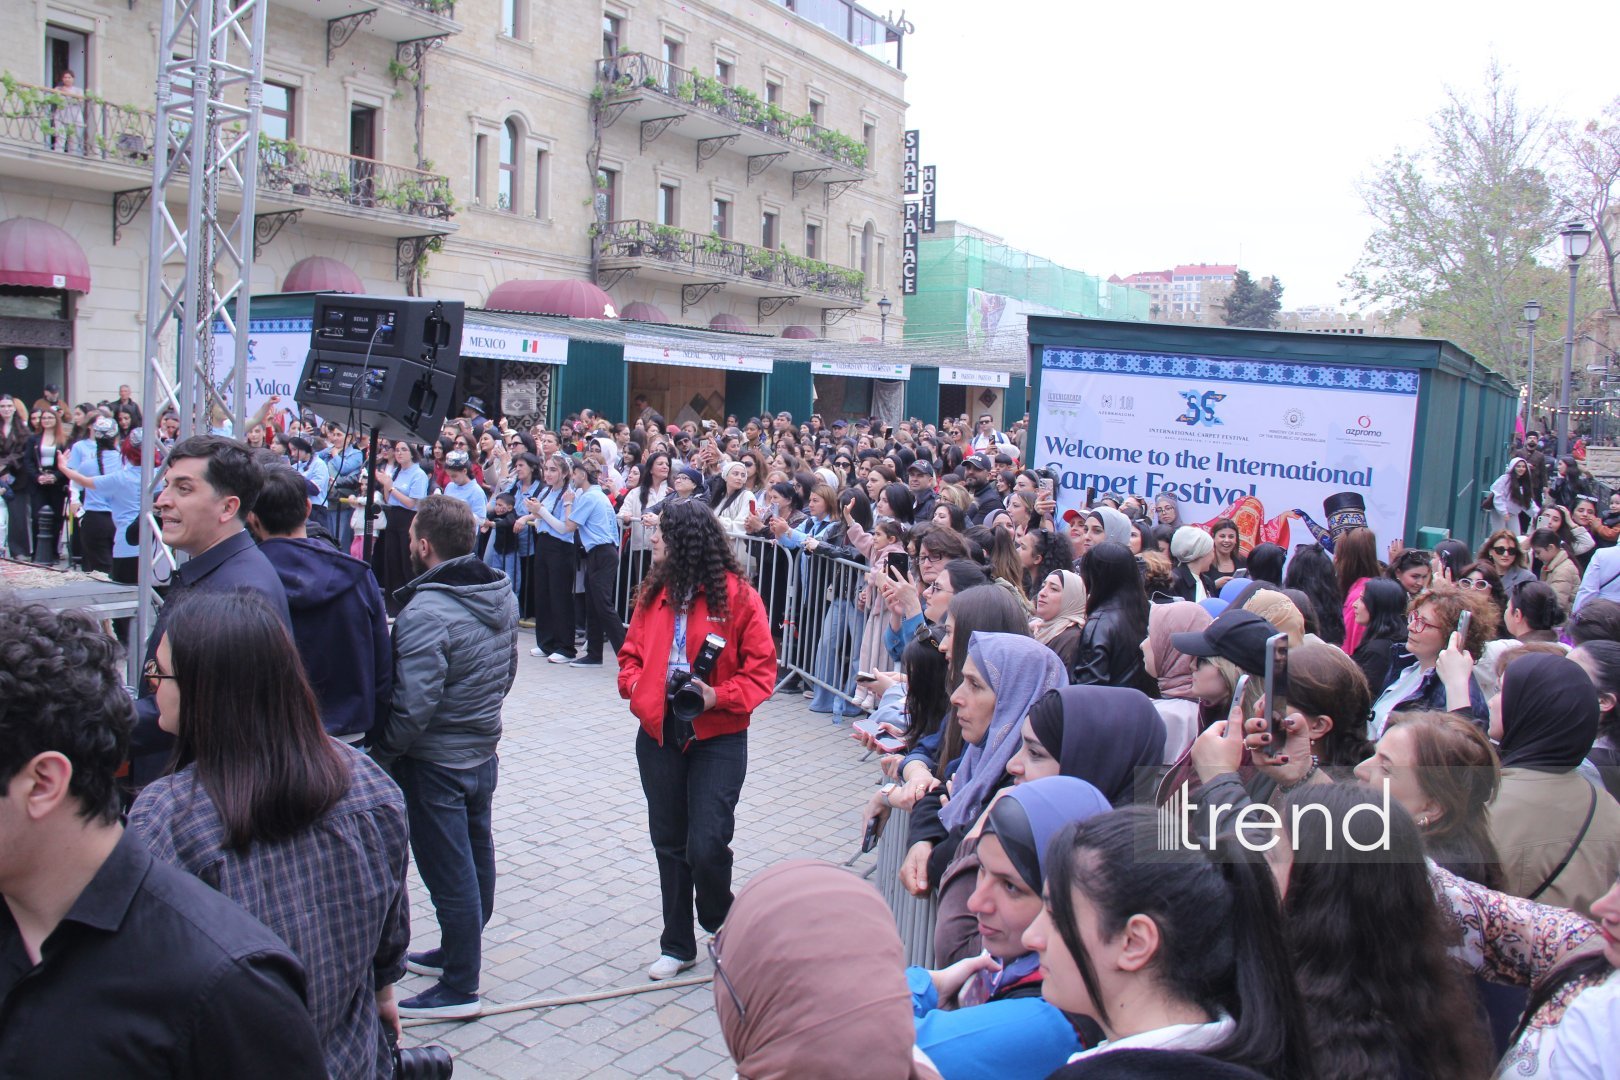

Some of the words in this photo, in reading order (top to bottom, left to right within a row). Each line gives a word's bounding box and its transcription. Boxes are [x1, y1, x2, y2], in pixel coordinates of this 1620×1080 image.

[904, 132, 916, 192] SHAH
[924, 168, 935, 231] HOTEL
[903, 204, 916, 294] PALACE
[469, 335, 506, 350] MEXICO
[1149, 428, 1195, 437] INTERNATIONAL
[1222, 434, 1249, 442] FESTIVAL
[1345, 428, 1381, 437] azpromo
[1044, 435, 1143, 464] Welcome
[1148, 449, 1170, 467] to
[1175, 450, 1211, 471] the
[1216, 452, 1373, 487] International
